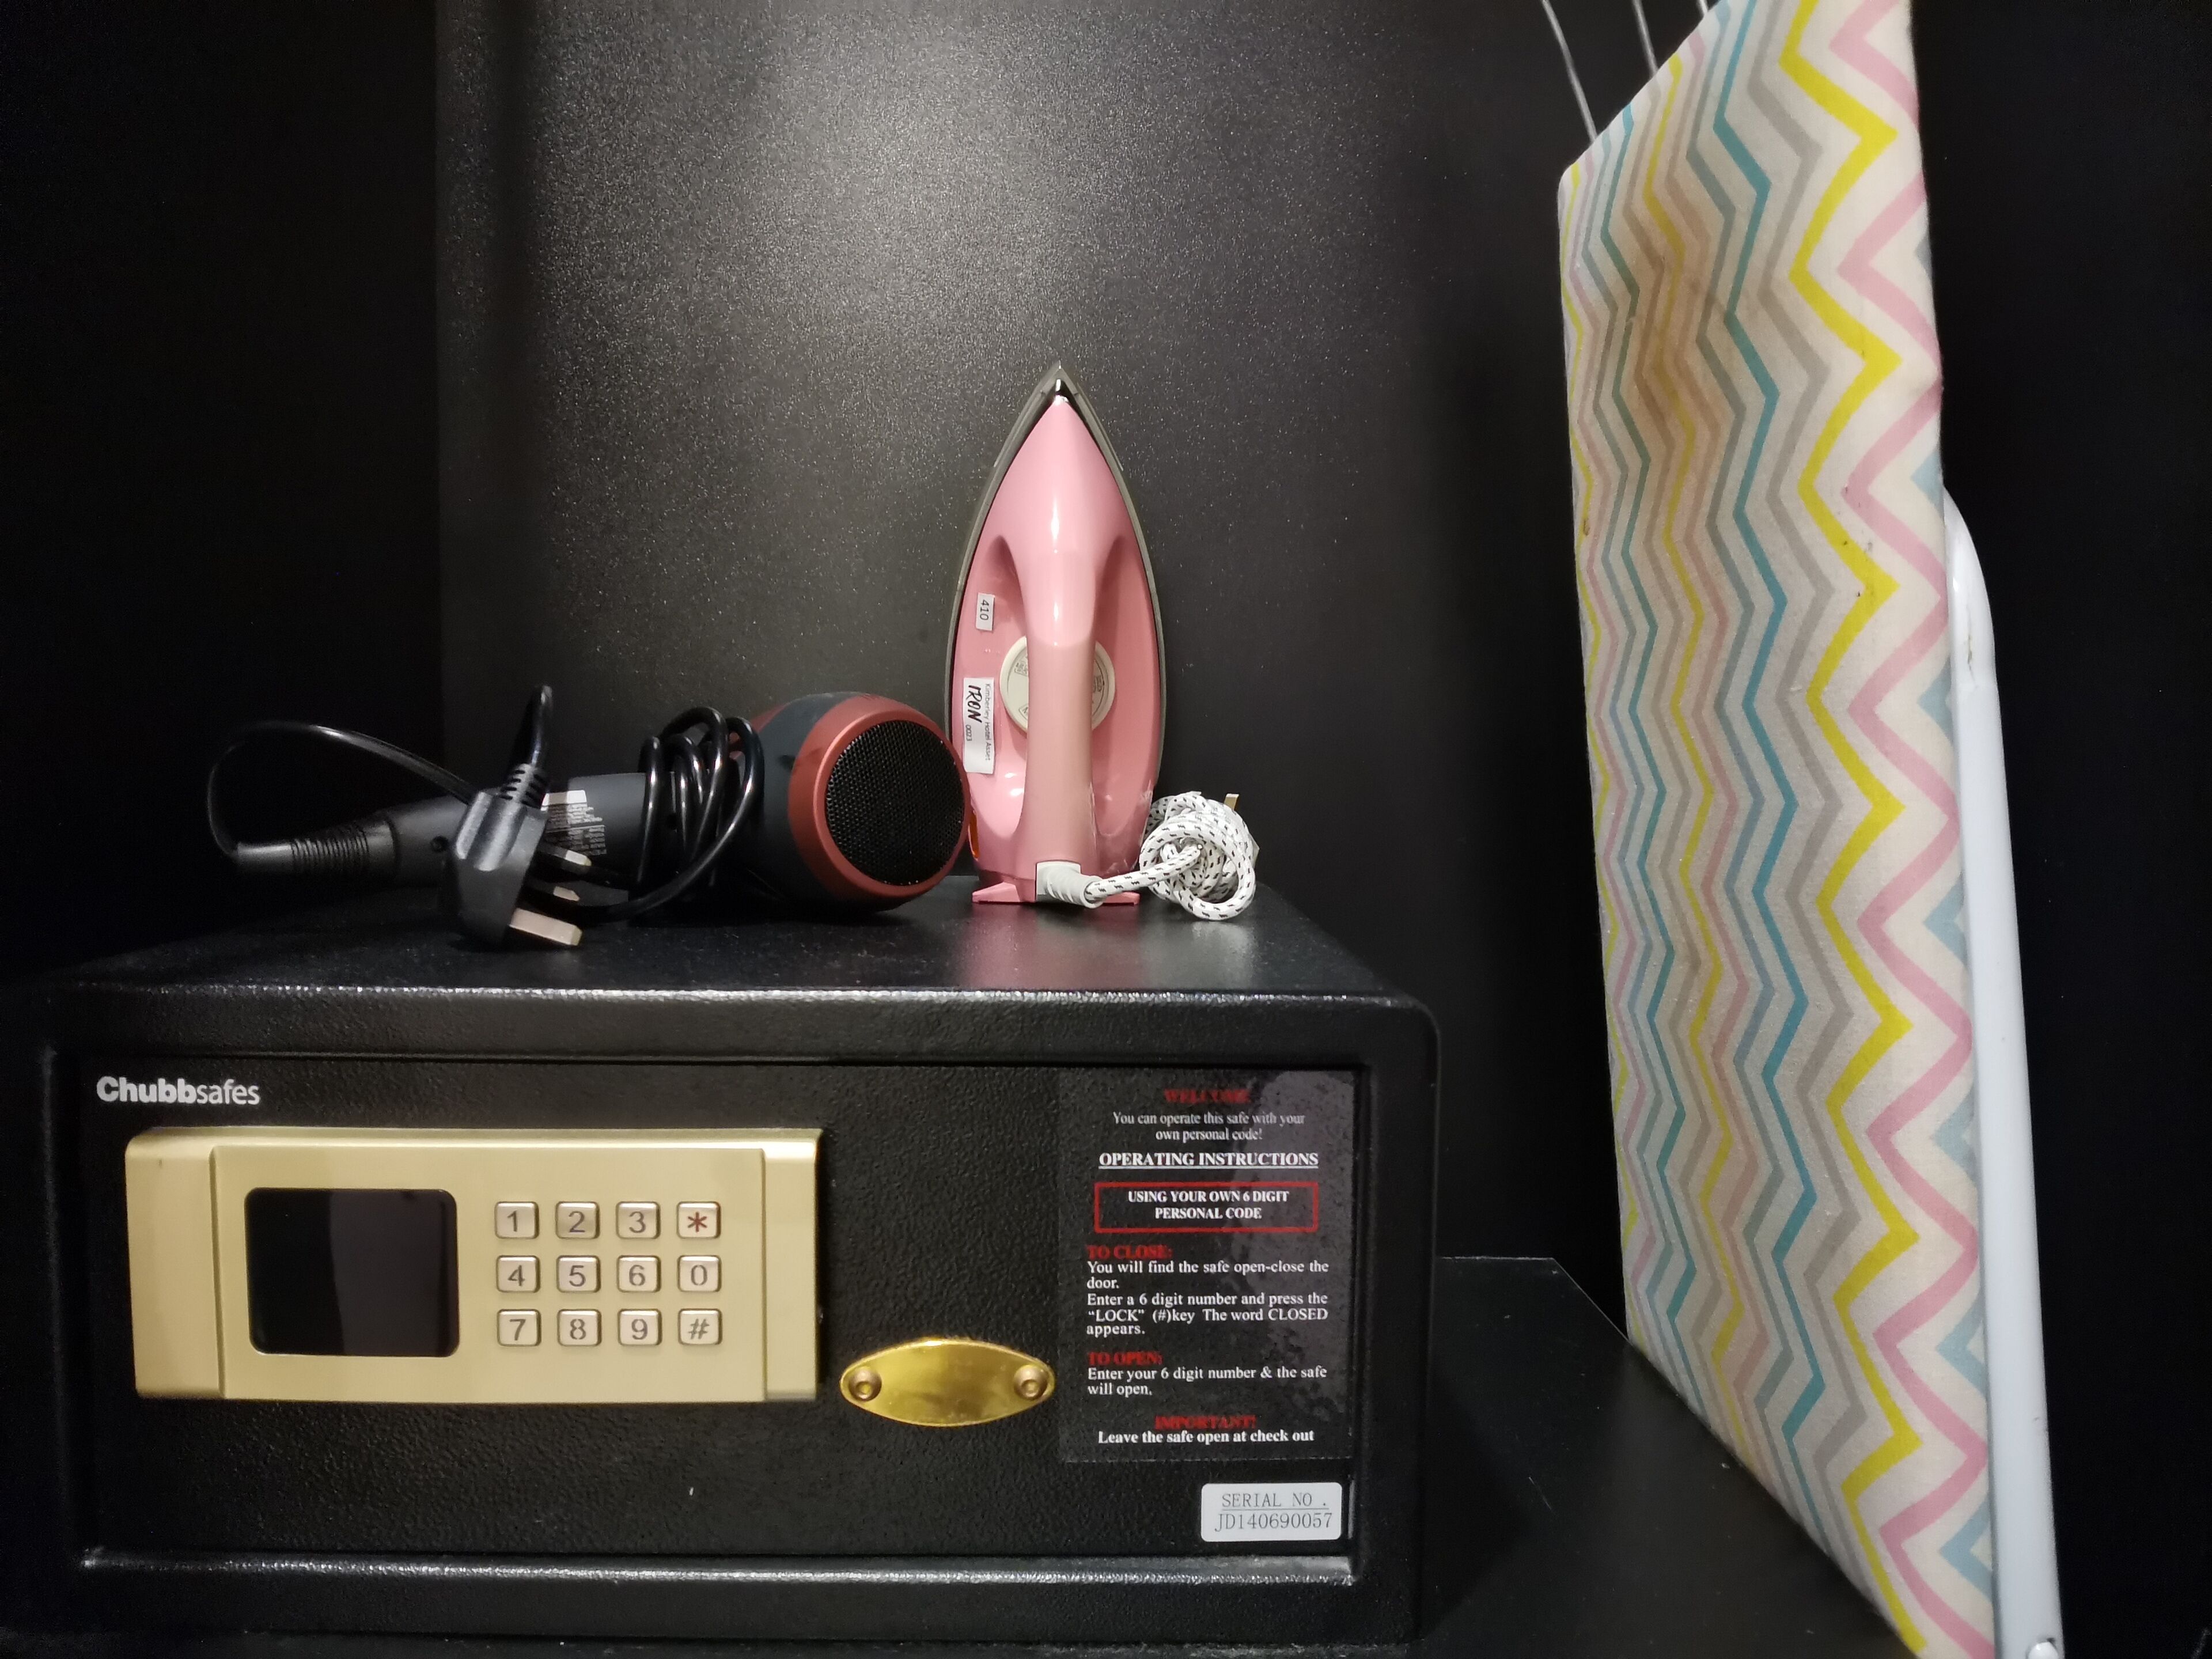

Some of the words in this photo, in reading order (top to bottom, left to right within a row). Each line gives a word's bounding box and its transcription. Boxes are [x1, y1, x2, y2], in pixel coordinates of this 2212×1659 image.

[979, 599, 990, 621] 410
[965, 684, 983, 723] IRON
[96, 1075, 260, 1105] Chubbsafes
[1112, 1111, 1135, 1125] You
[1137, 1115, 1157, 1125] can
[1160, 1113, 1202, 1127] operate
[1203, 1111, 1224, 1124] this
[1226, 1111, 1249, 1124] safe
[1251, 1111, 1277, 1125] with
[1279, 1115, 1305, 1127] your
[1156, 1130, 1180, 1141] own
[1182, 1128, 1230, 1143] personal
[1232, 1128, 1263, 1141] code!
[1099, 1152, 1195, 1166] OPERATING
[1198, 1152, 1319, 1166] INSTRUCTIONS
[1127, 1190, 1167, 1203] USING
[1169, 1190, 1207, 1203] YOUR
[1209, 1190, 1241, 1203] OWN
[1243, 1191, 1251, 1202] 6
[1252, 1190, 1290, 1203] DIGIT
[507, 1210, 518, 1233] 1
[569, 1211, 586, 1233] 2
[628, 1211, 646, 1233] 3
[1154, 1207, 1223, 1220] PERSONAL
[1225, 1207, 1263, 1219] CODE
[1087, 1245, 1111, 1259] TO
[507, 1264, 525, 1287] 4
[569, 1265, 586, 1287] 5
[628, 1264, 646, 1286] 6
[690, 1264, 708, 1286] 0
[1086, 1260, 1114, 1274] You
[1117, 1260, 1143, 1274] will
[1147, 1260, 1175, 1274] find
[1178, 1260, 1199, 1274] the
[1203, 1260, 1230, 1274] safe
[1233, 1260, 1305, 1275] open-close
[1309, 1260, 1330, 1272] the
[1086, 1275, 1120, 1289] door.
[1087, 1293, 1124, 1306] Enter
[1126, 1296, 1135, 1306] a
[1139, 1293, 1148, 1306] 6
[1151, 1291, 1184, 1308] digit
[1187, 1291, 1238, 1306] number
[1241, 1291, 1266, 1305] and
[1268, 1294, 1304, 1308] press
[1307, 1291, 1328, 1305] the
[1152, 1308, 1196, 1324] (#)key
[1202, 1308, 1228, 1321] The
[1230, 1308, 1264, 1321] word
[1268, 1307, 1329, 1321] CLOSED
[509, 1319, 526, 1341] 7
[569, 1319, 587, 1340] 8
[631, 1319, 649, 1340] 9
[687, 1319, 710, 1340] #
[1086, 1324, 1146, 1338] appears.
[1088, 1351, 1111, 1366] TO
[1088, 1367, 1124, 1380] Enter
[1126, 1369, 1158, 1383] your
[1160, 1367, 1169, 1380] 6
[1172, 1366, 1204, 1382] digit
[1208, 1366, 1257, 1380] number
[1260, 1366, 1273, 1379] &
[1277, 1366, 1298, 1378] the
[1300, 1365, 1328, 1378] safe
[1087, 1382, 1113, 1396] will
[1097, 1430, 1139, 1444] Leave
[1142, 1430, 1164, 1444] the
[1166, 1430, 1195, 1443] safe
[1196, 1432, 1230, 1445] open
[1232, 1431, 1248, 1443] at
[1249, 1429, 1290, 1442] check
[1291, 1430, 1315, 1442] out
[1221, 1493, 1282, 1508] SERIAL
[1214, 1512, 1333, 1532] JD140690057
